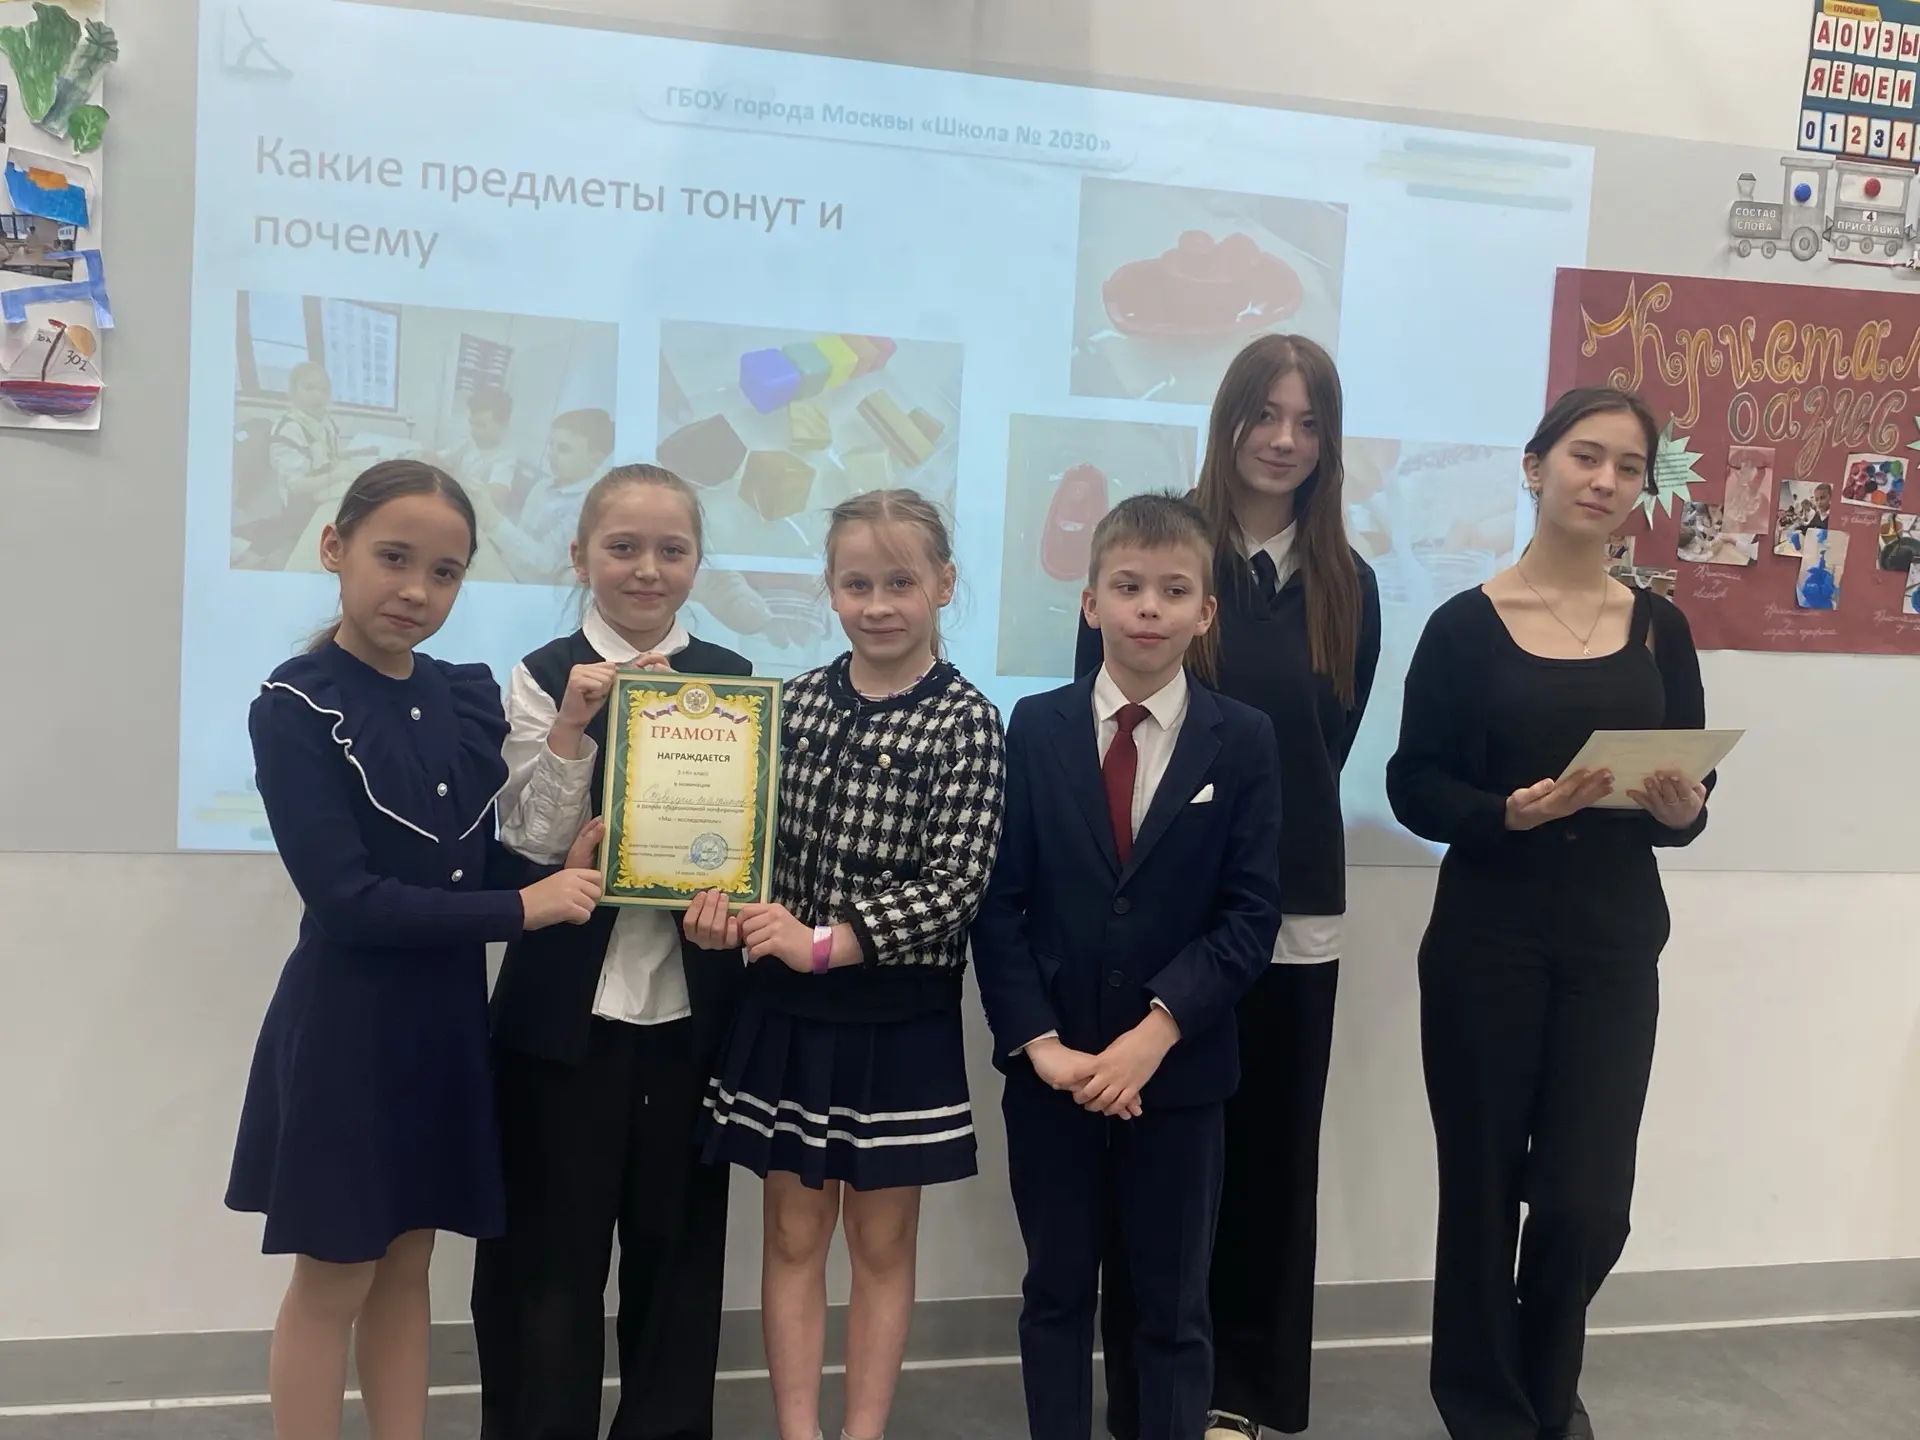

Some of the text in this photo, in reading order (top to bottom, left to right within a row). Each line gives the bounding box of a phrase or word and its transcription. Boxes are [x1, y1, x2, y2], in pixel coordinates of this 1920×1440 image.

[1817, 20, 1920, 57] А О У Э Ы
[1810, 64, 1912, 103] Я Ё Ю Е И
[665, 85, 1112, 153] ГБОУ города Москвы «Школа № 2030»
[1805, 120, 1906, 151] 0 1 2 3 4
[255, 135, 844, 233] Какие предметы тонут и
[1734, 207, 1777, 219] СОСТАВ
[1866, 211, 1875, 222] 4
[1736, 220, 1773, 232] СЛОВА
[1837, 220, 1901, 237] ПРИСТАВКА
[253, 214, 439, 270] почему
[651, 725, 738, 743] ГРАМОТА
[657, 751, 731, 764] НАГРАЖДАЕТСЯ
